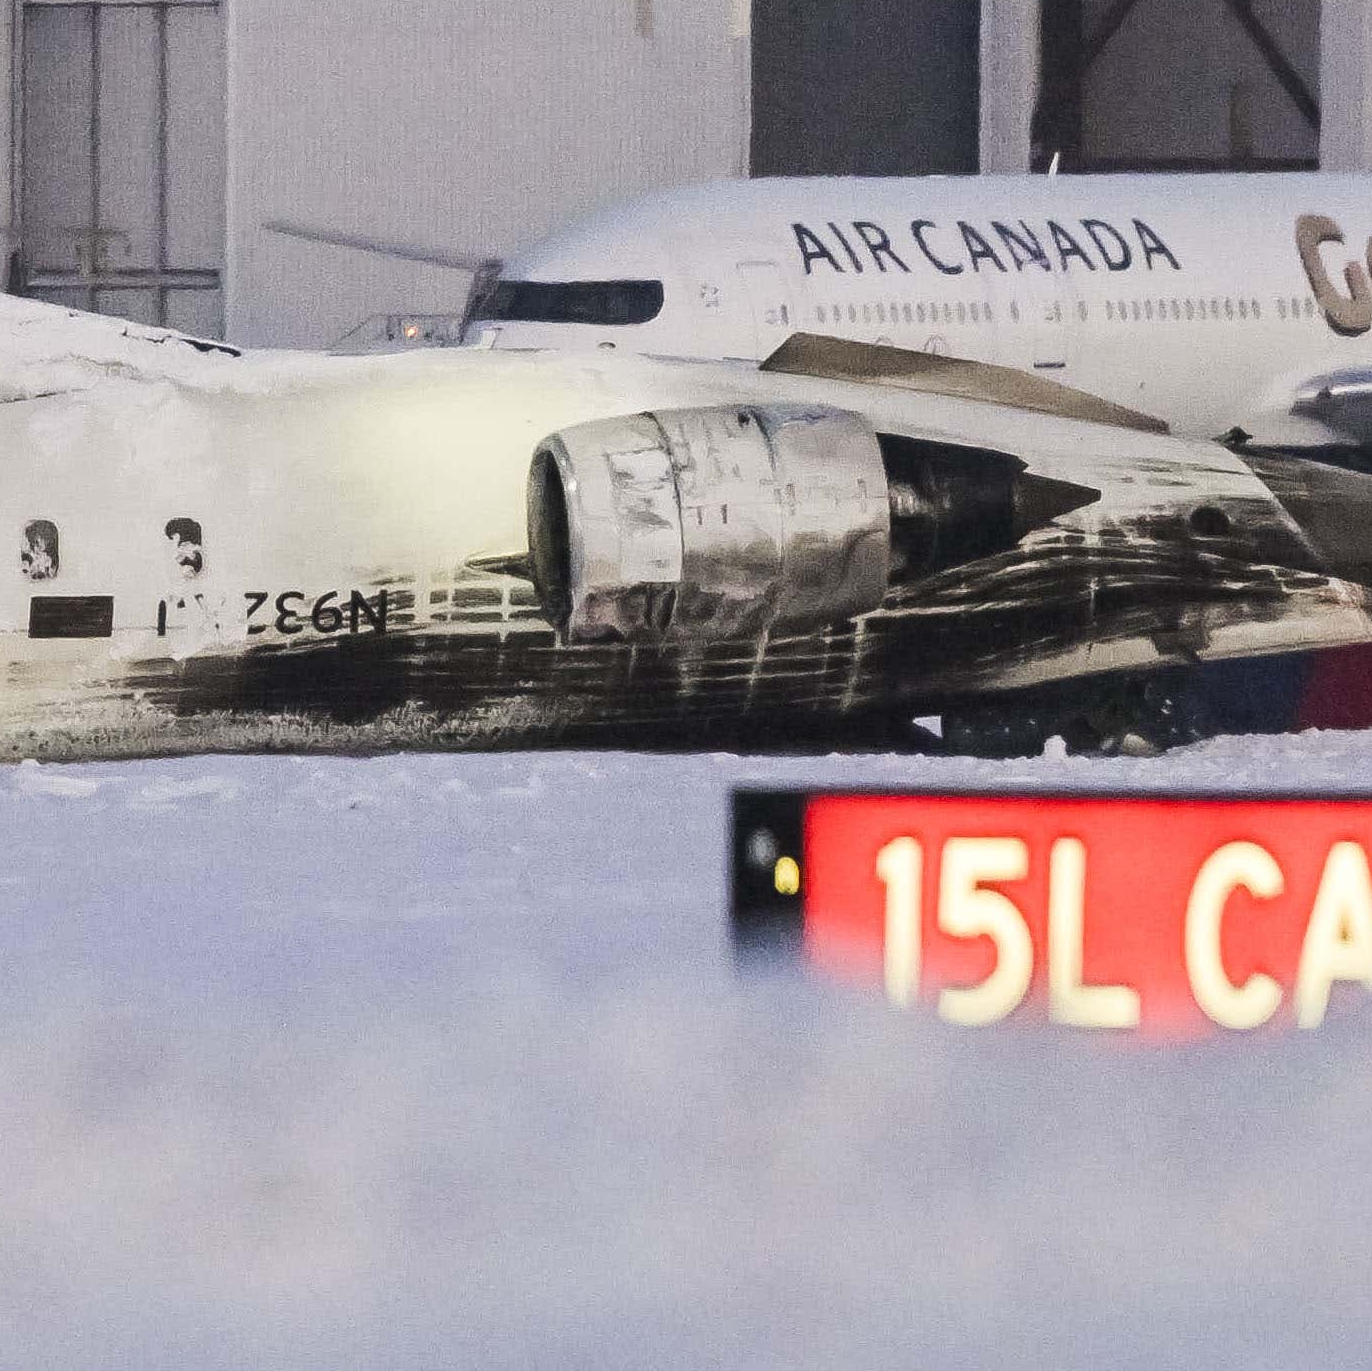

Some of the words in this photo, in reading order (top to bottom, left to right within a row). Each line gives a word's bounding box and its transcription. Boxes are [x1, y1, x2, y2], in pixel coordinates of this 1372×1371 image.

[792, 221, 913, 274] AIR
[911, 218, 1181, 275] CANADA
[876, 836, 1143, 1030] 15L
